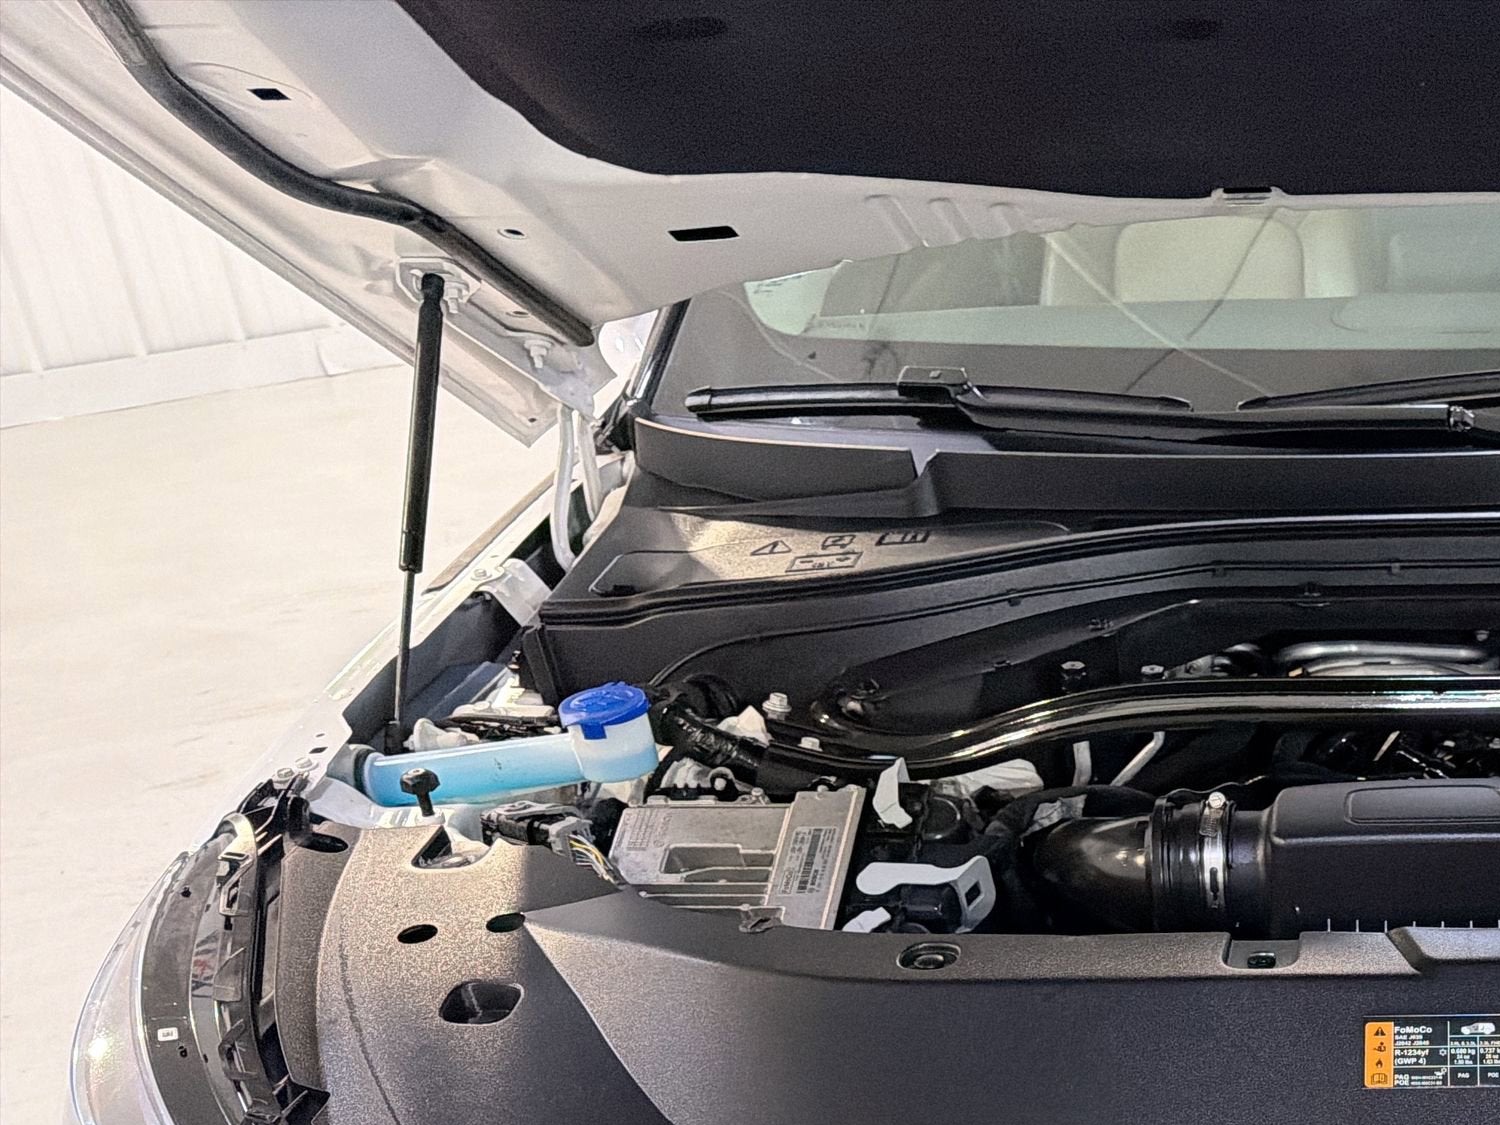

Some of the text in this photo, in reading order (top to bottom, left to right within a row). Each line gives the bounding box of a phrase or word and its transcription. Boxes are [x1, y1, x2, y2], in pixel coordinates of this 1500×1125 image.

[1394, 1049, 1429, 1057] R-1234yf
[1394, 1057, 1427, 1066] (GWP 4)
